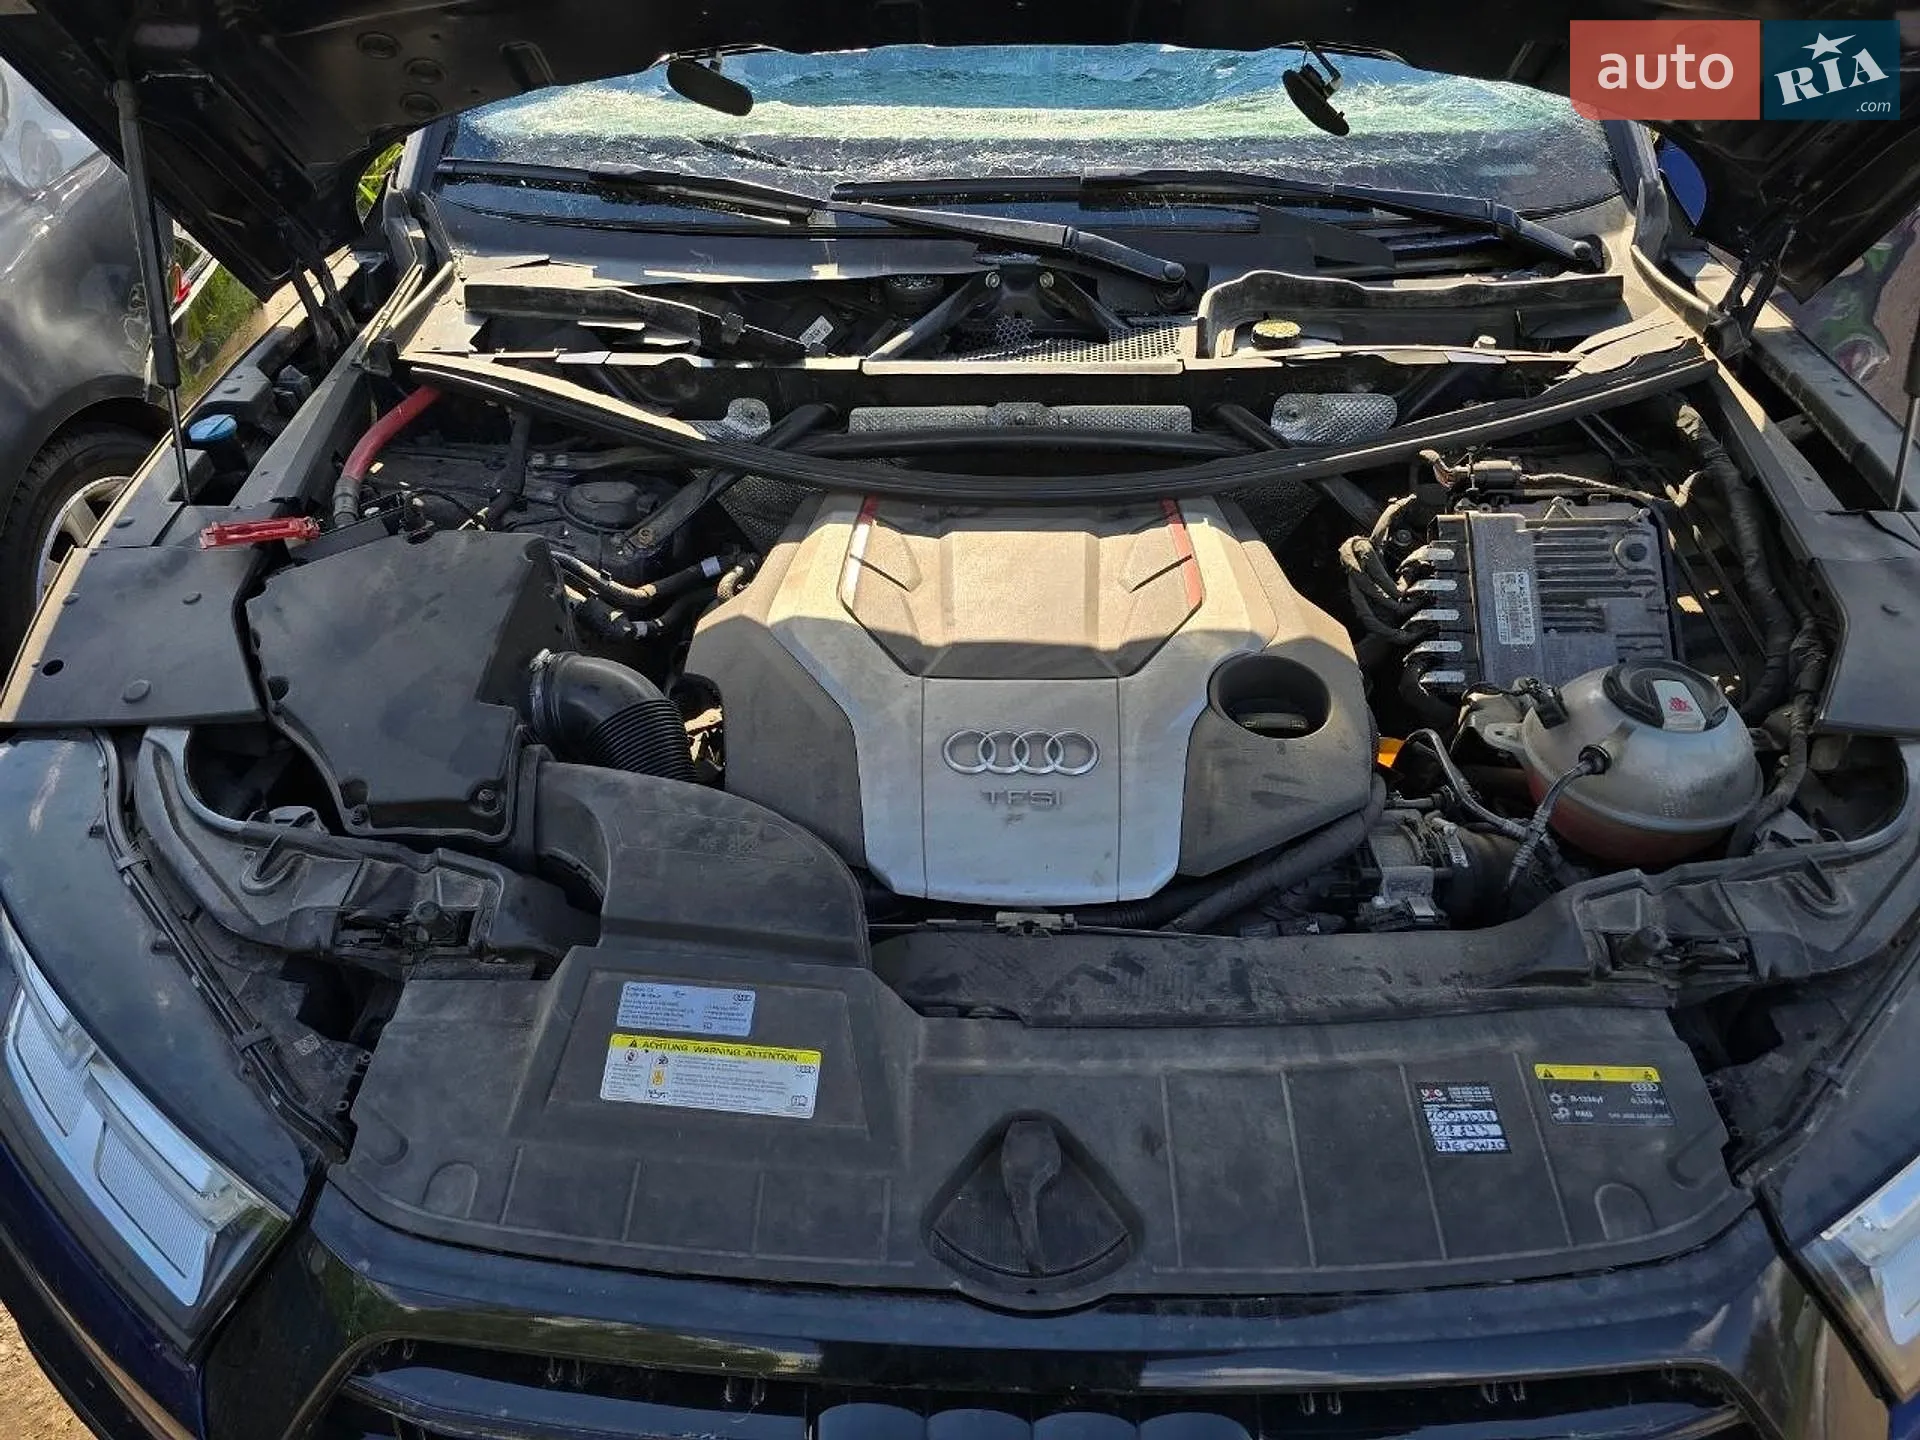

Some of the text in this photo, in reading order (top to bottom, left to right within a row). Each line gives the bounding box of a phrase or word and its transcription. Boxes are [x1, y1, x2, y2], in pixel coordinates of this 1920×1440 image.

[982, 790, 1063, 805] TFSI
[642, 1040, 799, 1062] ACHTUNG WARNING ATTENTION
